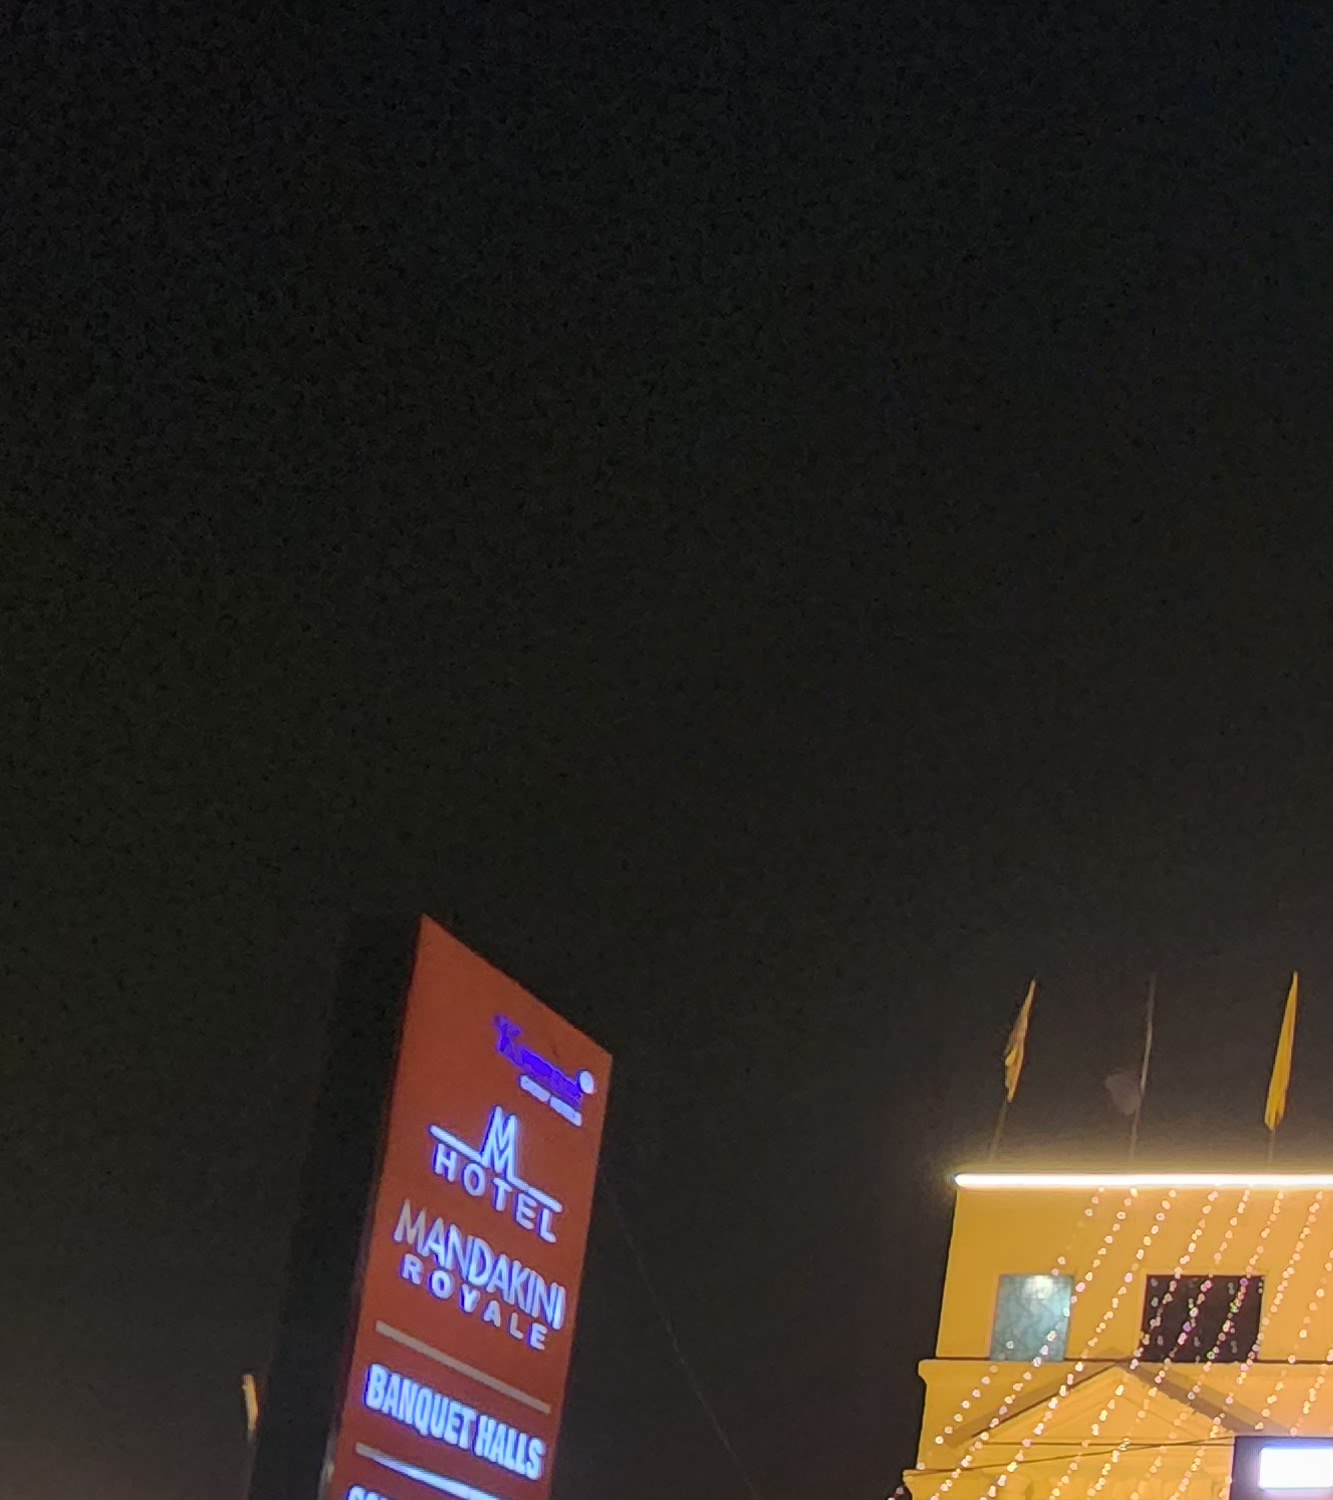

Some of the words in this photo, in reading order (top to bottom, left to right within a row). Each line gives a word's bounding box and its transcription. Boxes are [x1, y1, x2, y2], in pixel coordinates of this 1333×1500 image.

[433, 1143, 557, 1243] HOTEL
[393, 1199, 566, 1331] MANDAKINI
[401, 1253, 549, 1350] ROYALE
[364, 1363, 476, 1450] BANQUET
[473, 1414, 545, 1481] HALLS
